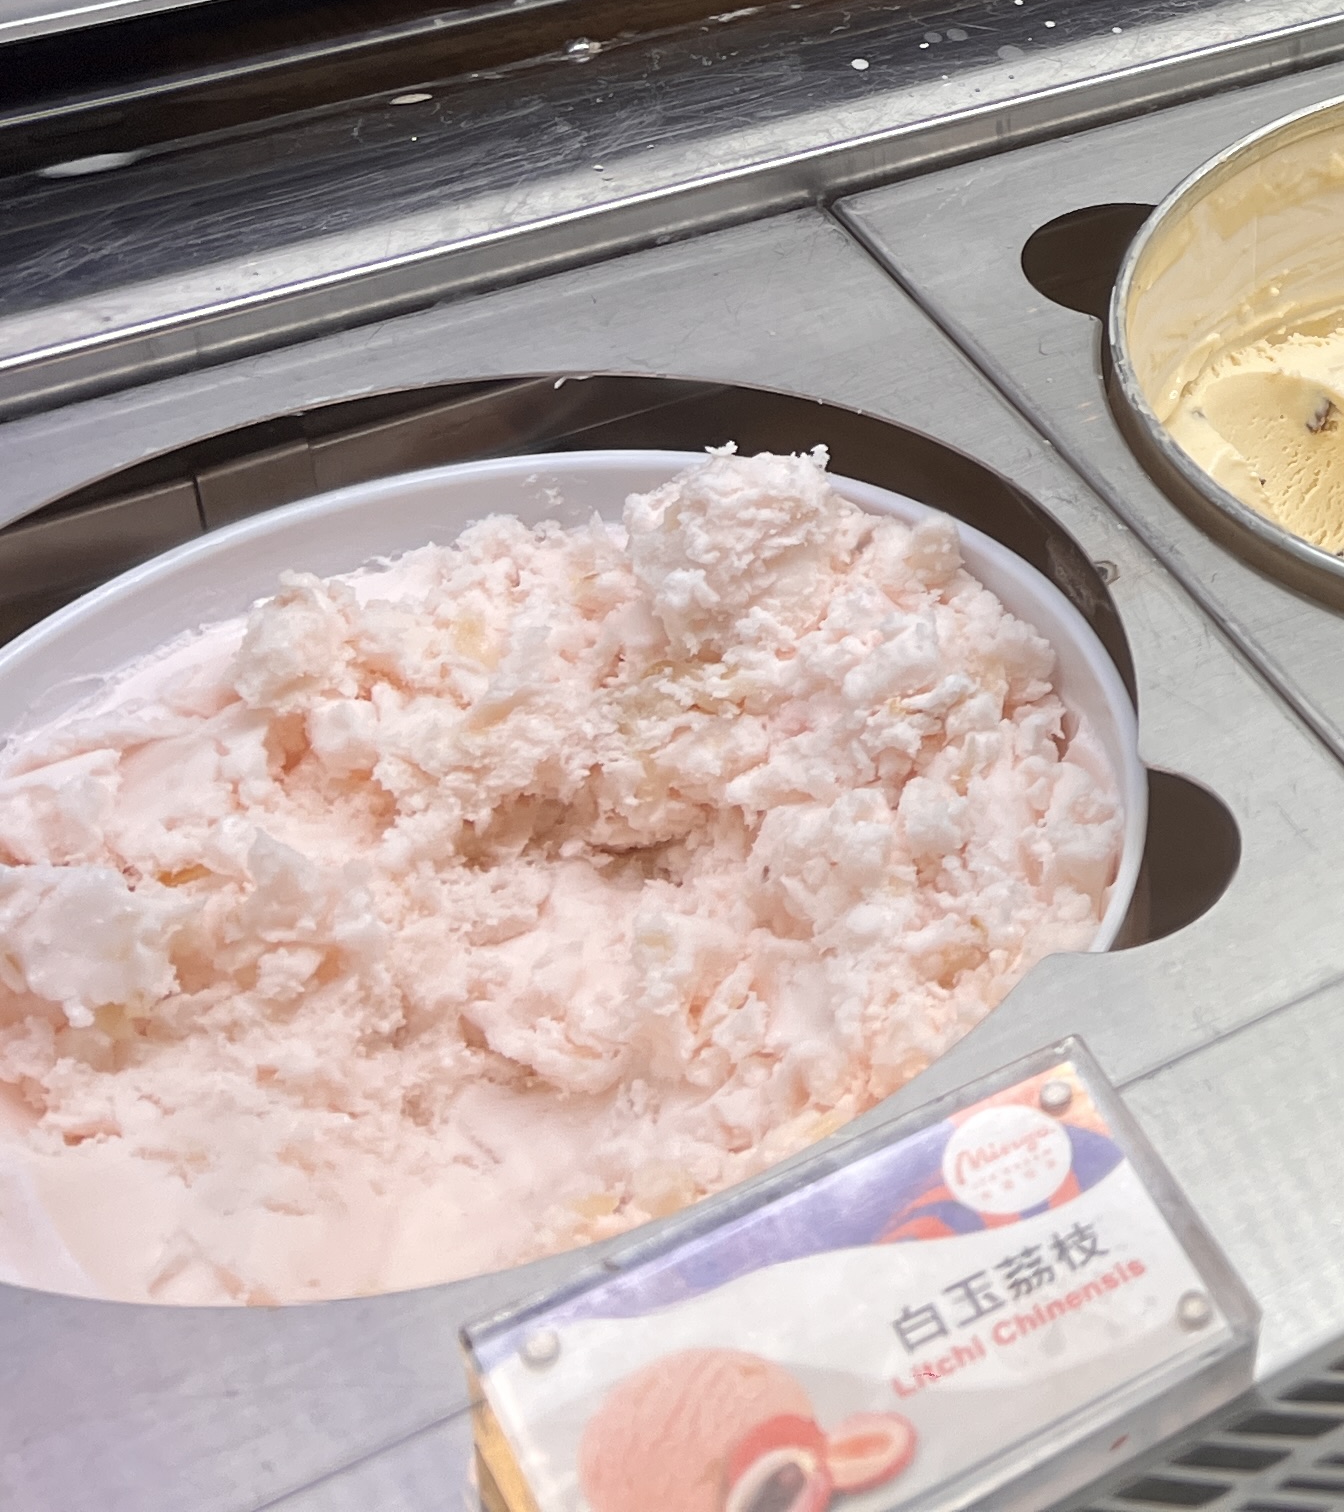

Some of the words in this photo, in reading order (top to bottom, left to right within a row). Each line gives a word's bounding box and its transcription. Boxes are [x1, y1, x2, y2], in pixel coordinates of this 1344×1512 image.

[890, 1334, 987, 1400] Litchi
[990, 1258, 1147, 1347] Chinensis
[891, 1221, 1110, 1354] 白玉荔枝
